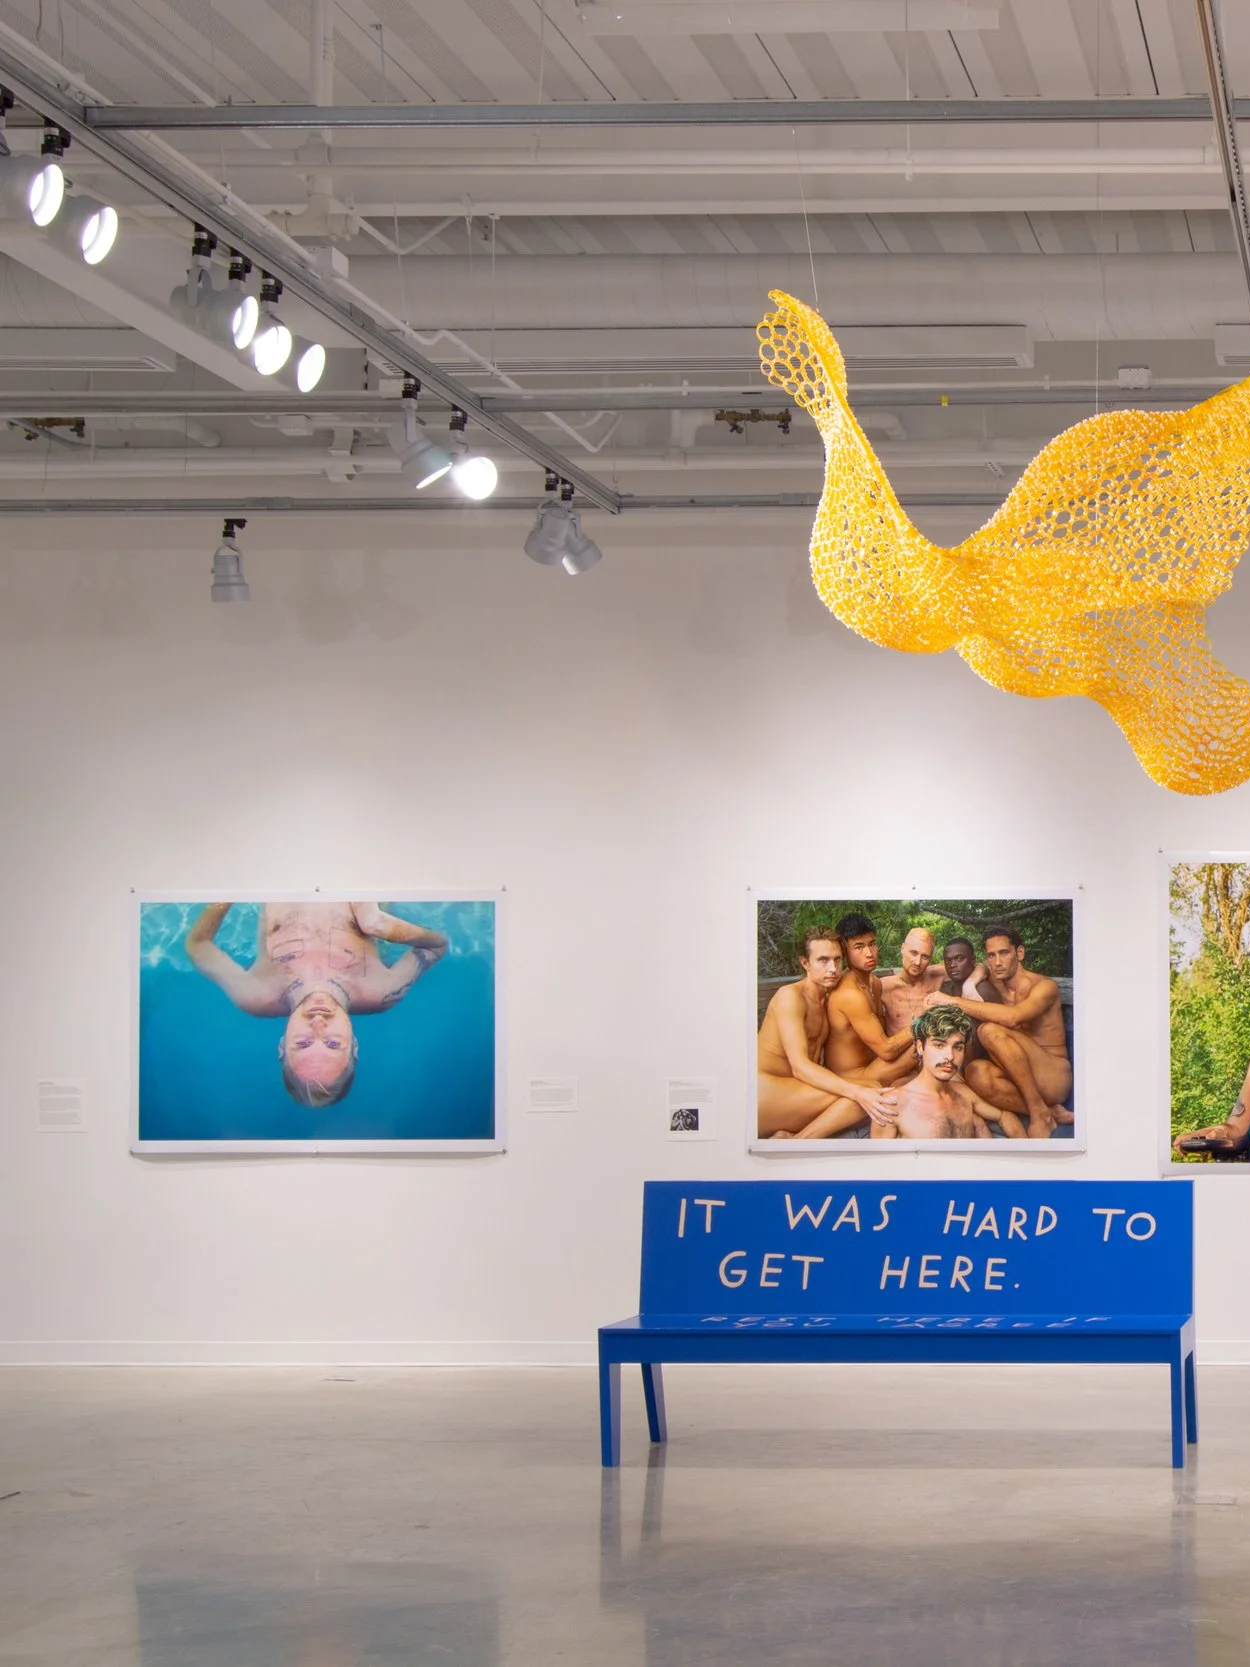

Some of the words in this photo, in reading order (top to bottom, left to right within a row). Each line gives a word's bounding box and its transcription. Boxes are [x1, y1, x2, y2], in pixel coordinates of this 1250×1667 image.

[678, 1198, 726, 1238] IT
[784, 1194, 897, 1233] WAS
[943, 1199, 1058, 1241] HARD
[1092, 1207, 1157, 1242] TO
[718, 1250, 824, 1290] GET
[879, 1254, 1021, 1293] HERE.
[732, 1321, 831, 1329] YOU
